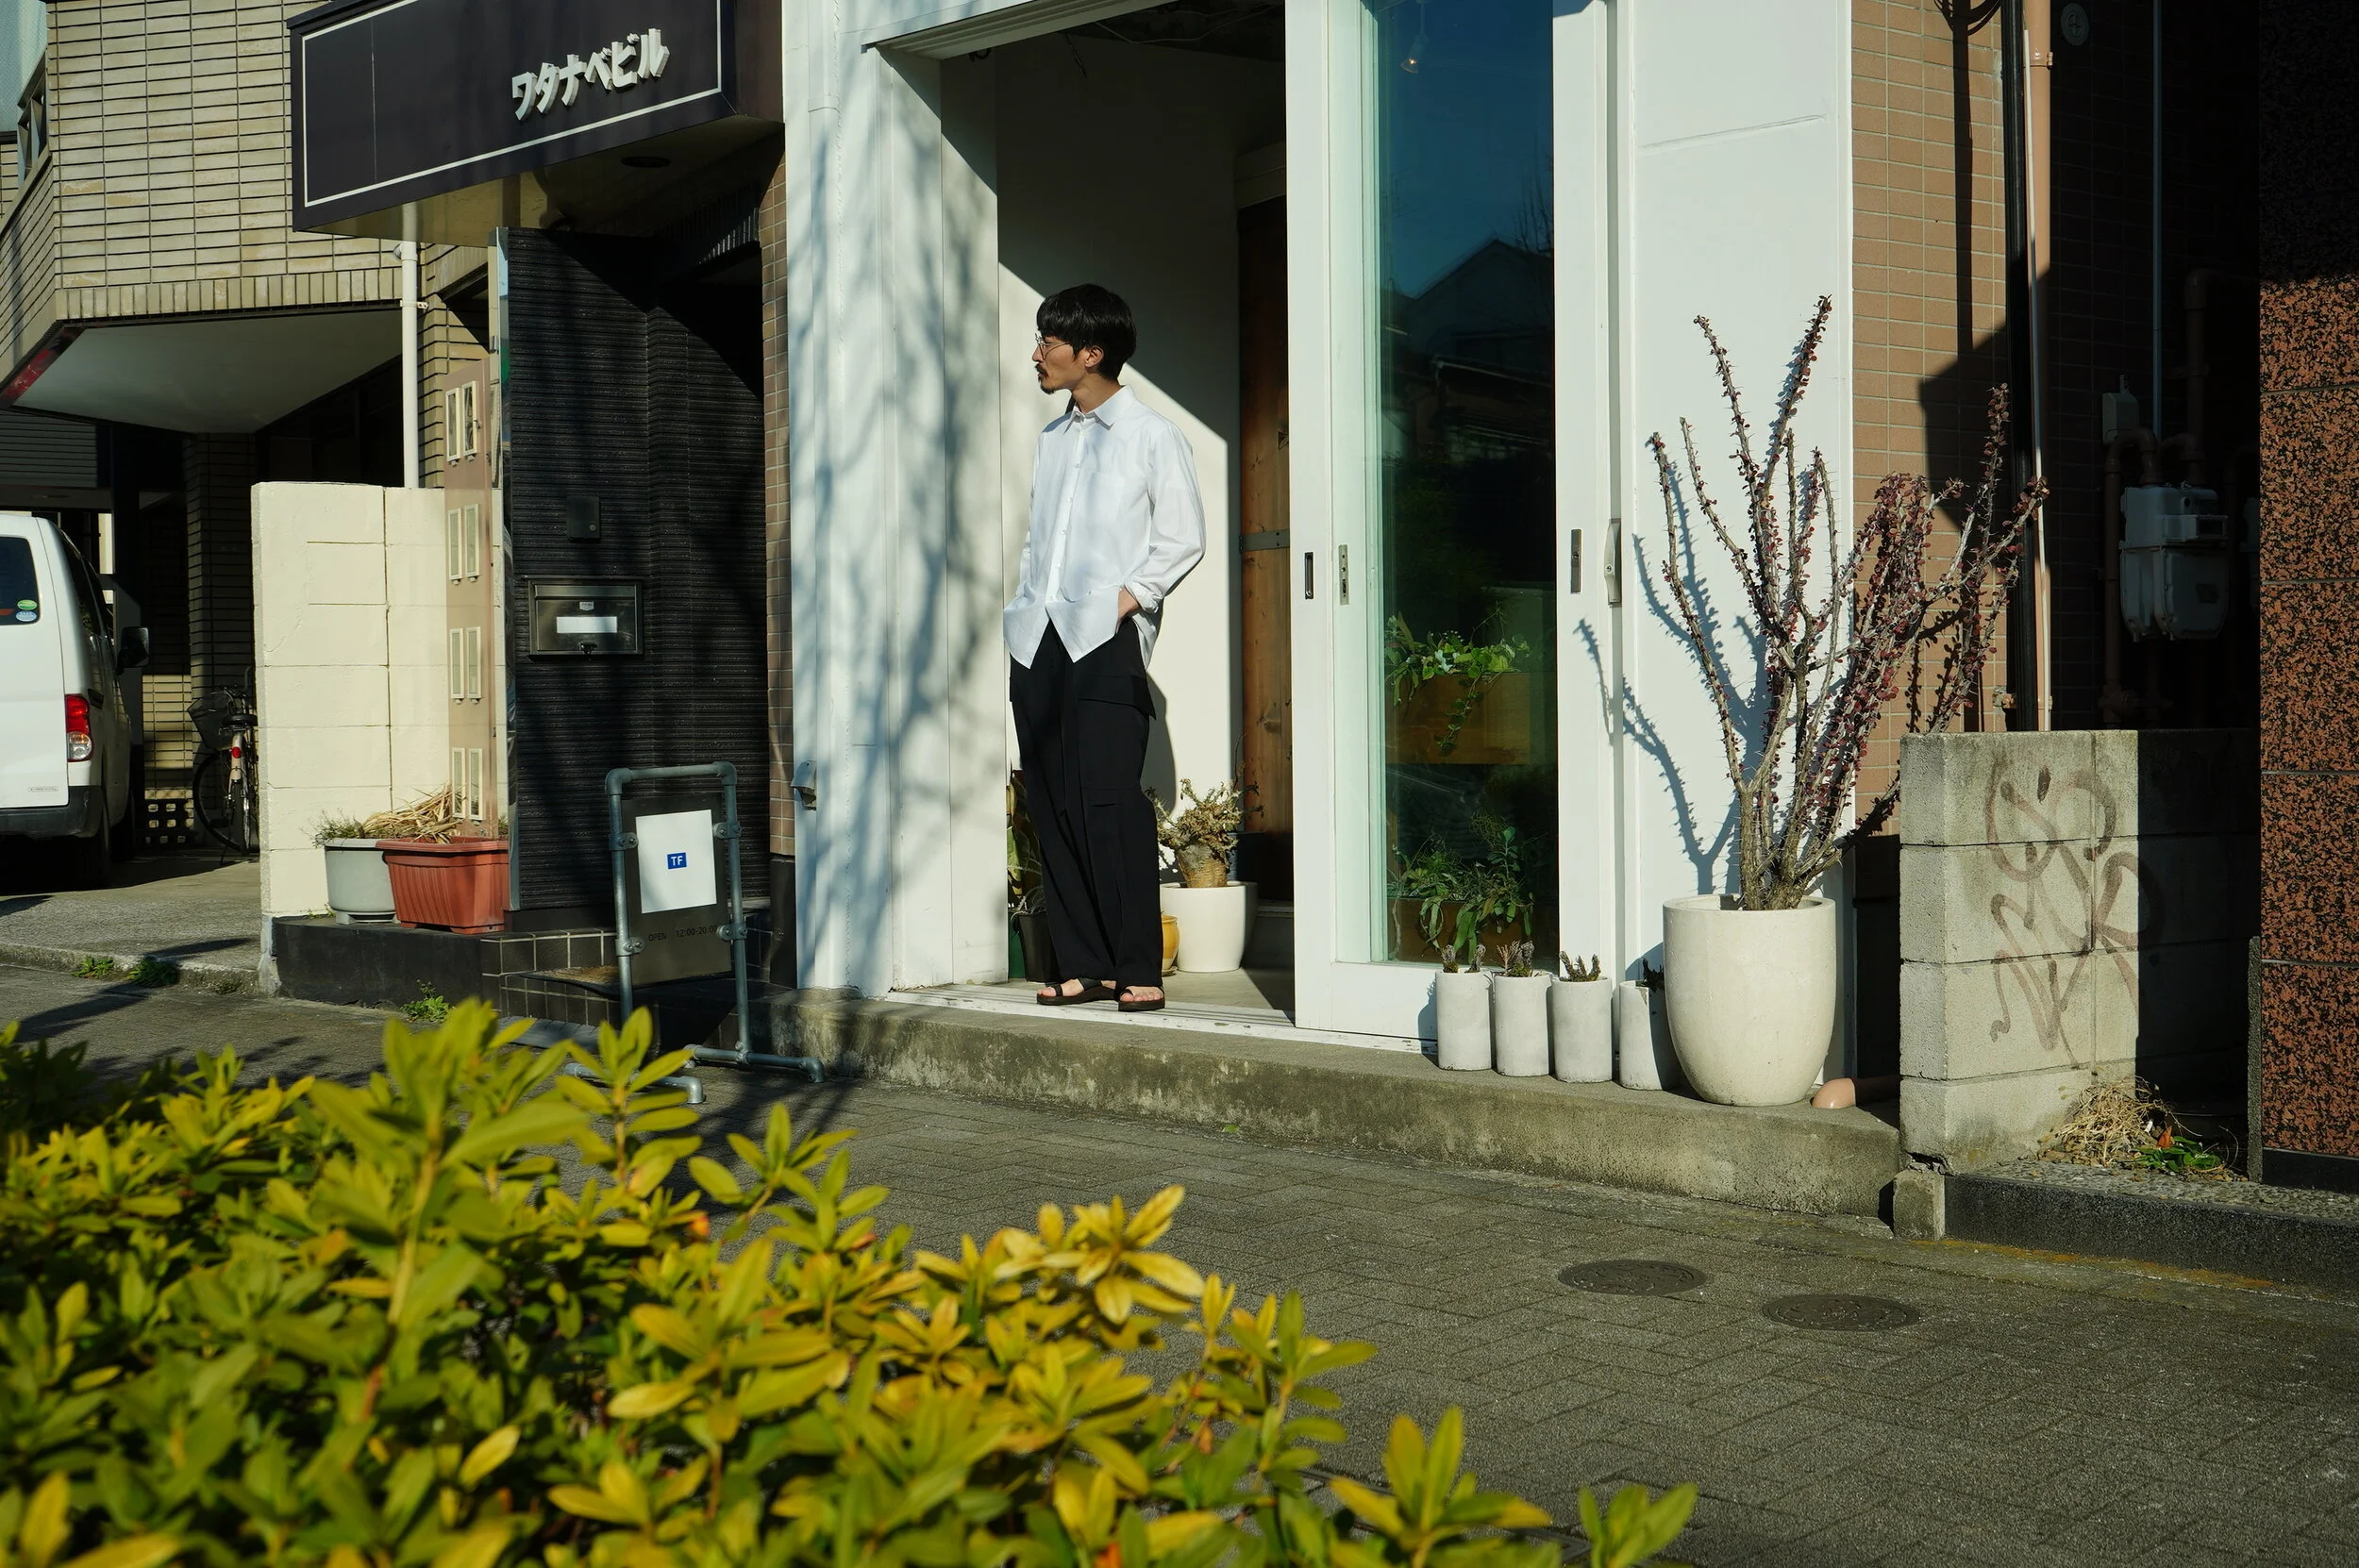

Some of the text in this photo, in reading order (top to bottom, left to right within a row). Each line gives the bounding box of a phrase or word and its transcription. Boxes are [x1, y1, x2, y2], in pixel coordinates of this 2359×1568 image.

[511, 27, 671, 121] ワタナベビル
[670, 855, 683, 866] TF
[648, 932, 667, 942] OPEN
